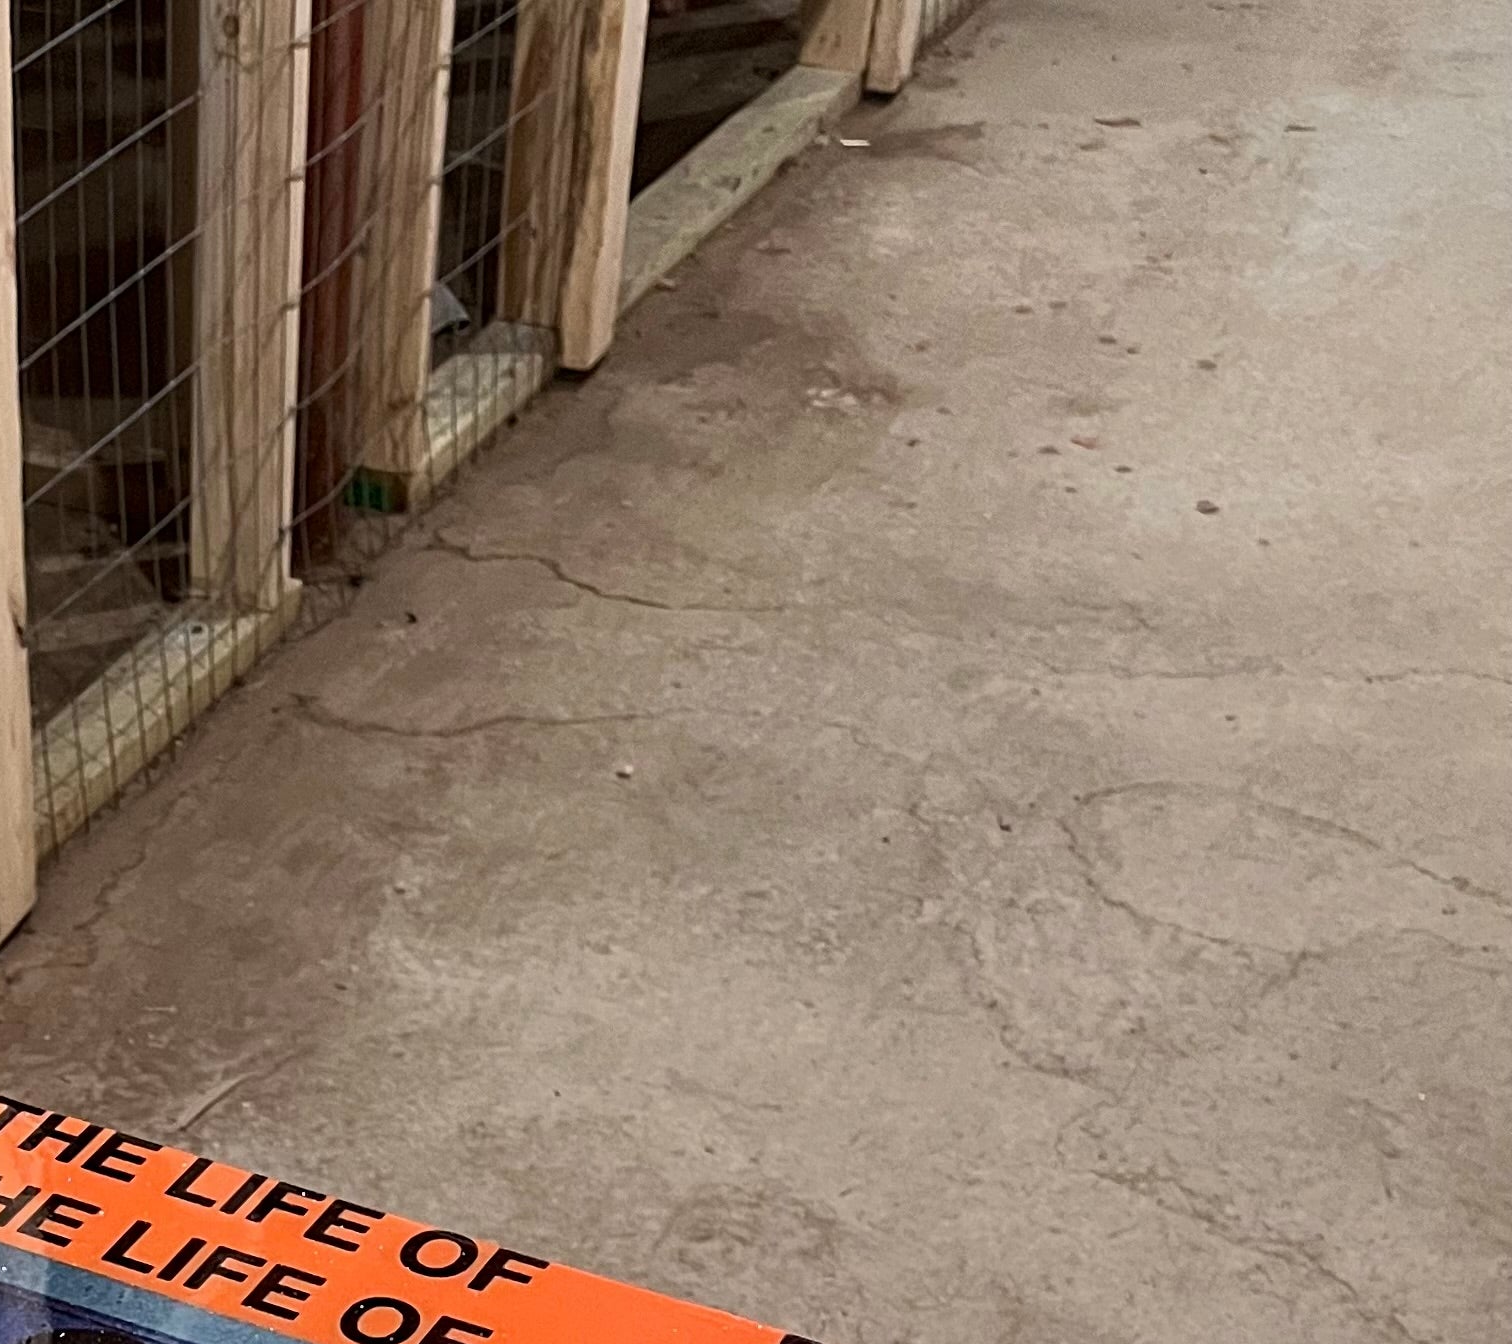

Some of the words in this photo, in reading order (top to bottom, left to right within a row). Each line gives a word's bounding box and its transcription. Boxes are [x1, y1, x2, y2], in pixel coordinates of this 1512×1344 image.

[101, 1220, 326, 1320] LIFE
[165, 1157, 386, 1252] LIFE
[399, 1229, 551, 1291] OF
